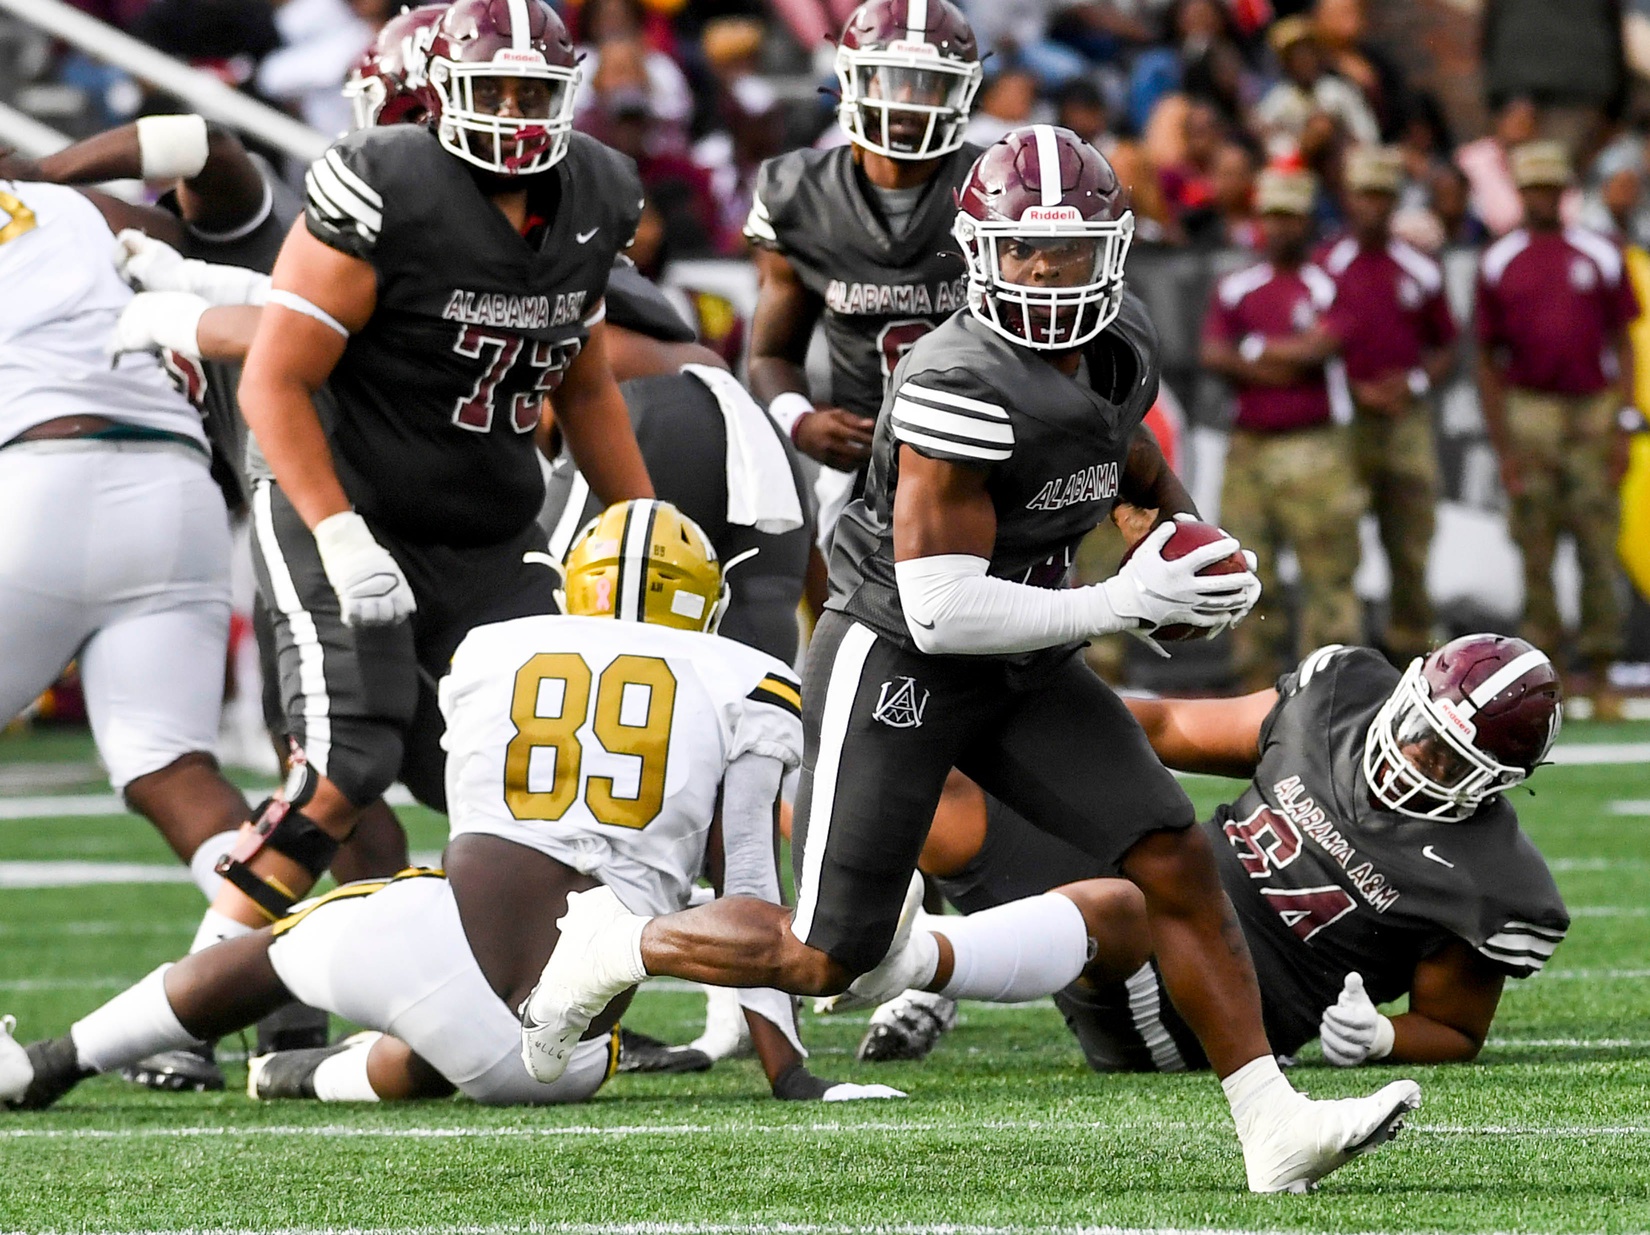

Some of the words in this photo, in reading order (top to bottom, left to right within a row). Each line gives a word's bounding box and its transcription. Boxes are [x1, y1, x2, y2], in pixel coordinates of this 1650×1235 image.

[503, 51, 542, 63] Riddell
[1030, 210, 1076, 221] Riddell
[442, 288, 549, 330] ALABAMA
[825, 279, 934, 315] ALABAMA
[935, 280, 969, 315] A&
[452, 323, 582, 434] 73
[1025, 461, 1120, 511] ALABAMA
[503, 652, 678, 831] 89
[1273, 775, 1357, 870] ALABAMA
[1346, 862, 1401, 914] A&M
